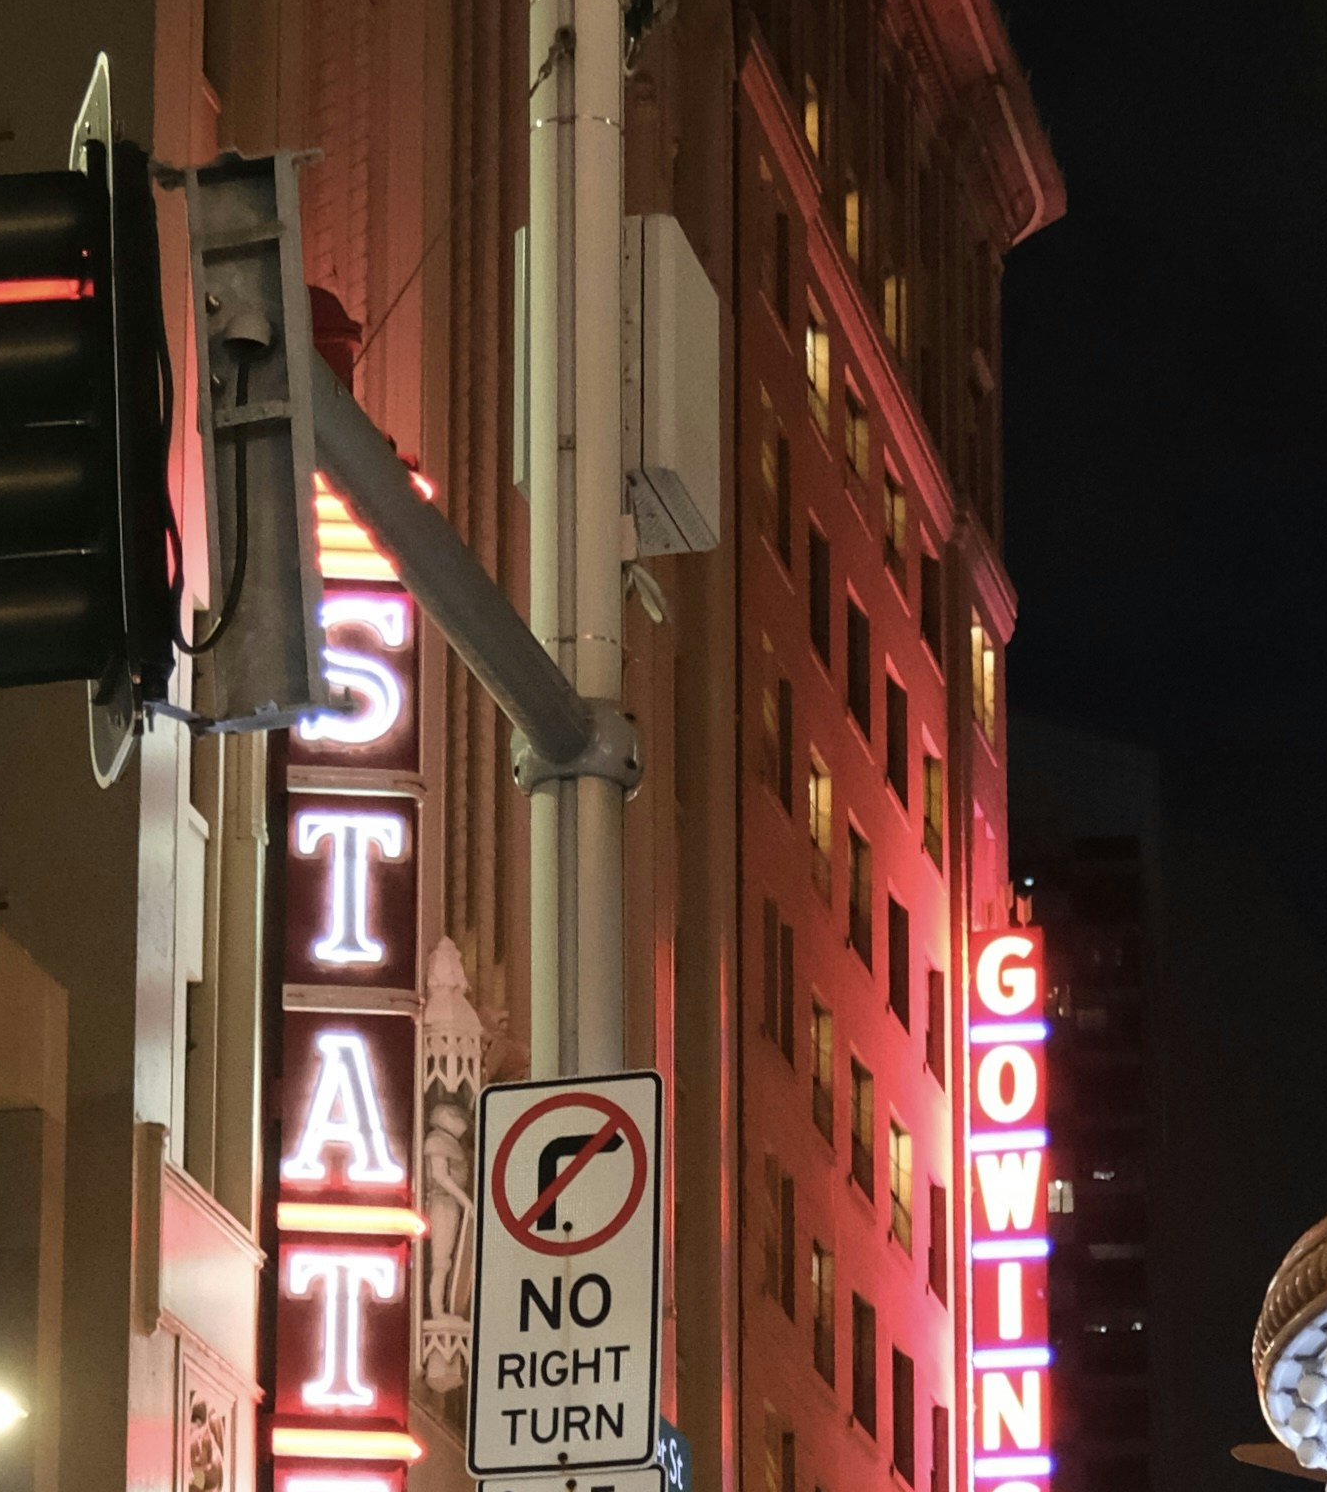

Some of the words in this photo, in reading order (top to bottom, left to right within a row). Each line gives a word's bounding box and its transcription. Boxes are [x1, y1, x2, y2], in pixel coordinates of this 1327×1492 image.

[519, 1273, 612, 1332] NO
[497, 1345, 630, 1389] RIGHT
[501, 1403, 624, 1446] TURN
[669, 1437, 684, 1491] St
